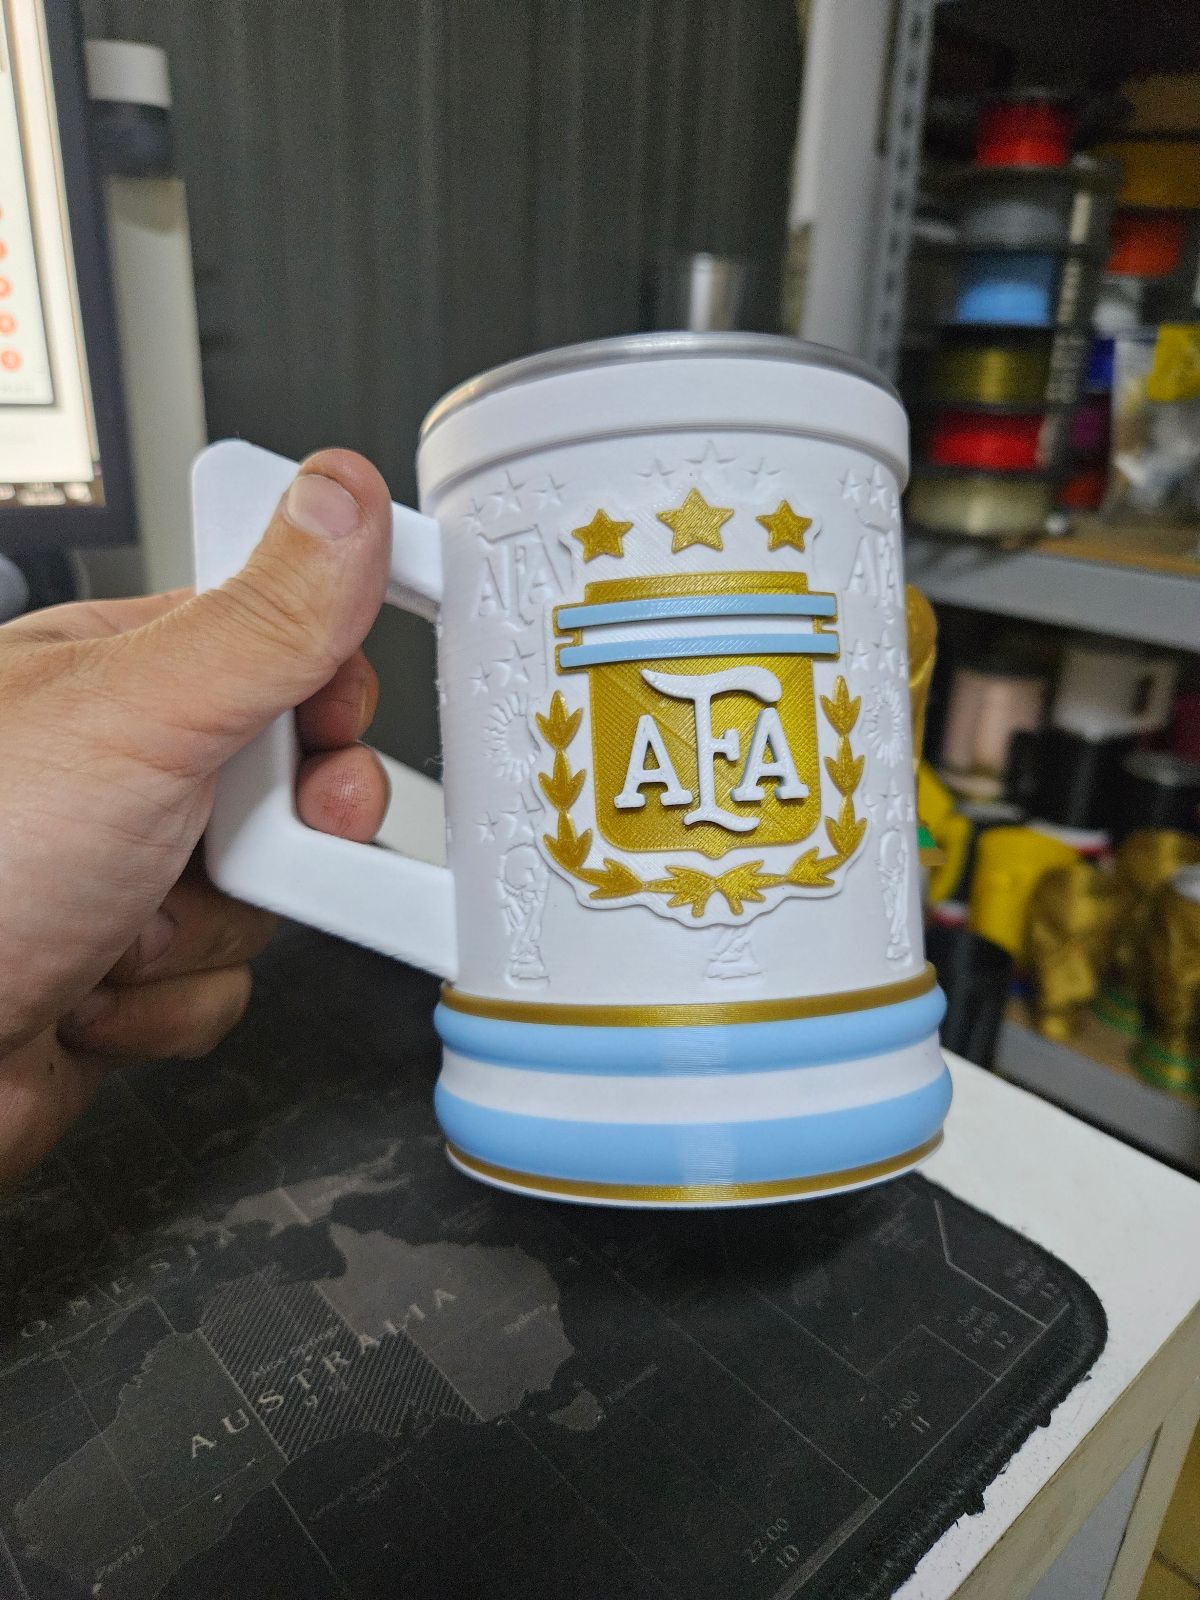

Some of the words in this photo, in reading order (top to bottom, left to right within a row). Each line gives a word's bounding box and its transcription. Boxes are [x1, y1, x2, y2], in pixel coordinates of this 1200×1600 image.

[613, 664, 810, 833] AFA
[191, 1287, 458, 1459] AUSTRALIA
[882, 1389, 922, 1430] 23:00
[742, 1517, 791, 1564] 22:00
[774, 1543, 801, 1569] 10
